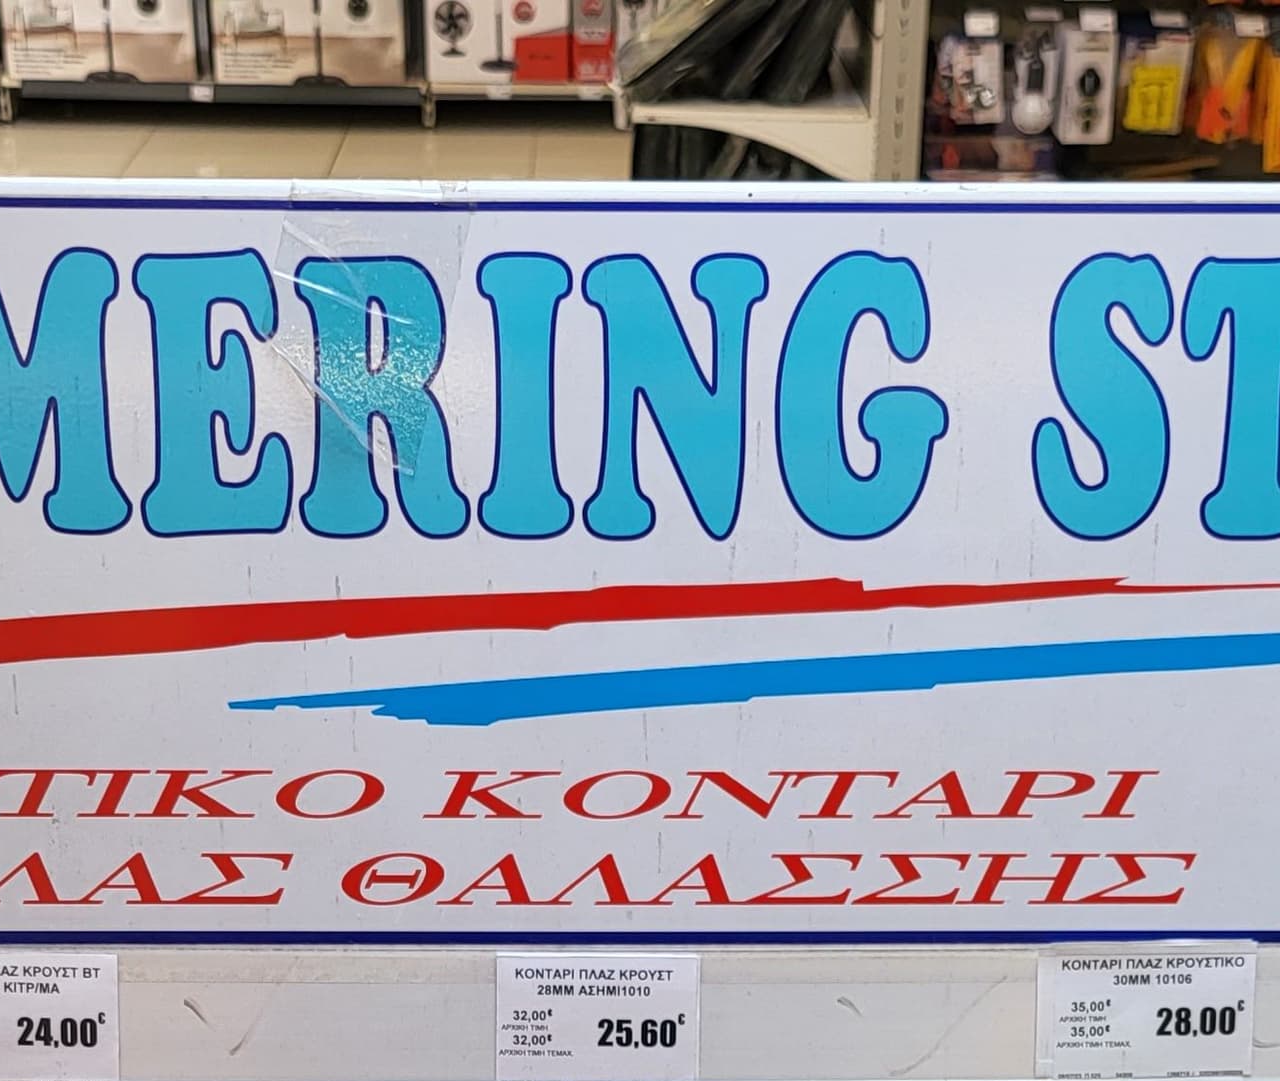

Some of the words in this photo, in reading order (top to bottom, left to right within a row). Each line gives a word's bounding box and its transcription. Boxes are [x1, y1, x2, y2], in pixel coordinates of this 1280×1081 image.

[422, 769, 1161, 820] ΚΟΝΤΑΡΙ
[341, 852, 1197, 907] ΘΑΛΑΣΣΗΣ
[1062, 959, 1121, 970] ΚΟΝΤΑΡΙ
[1126, 958, 1163, 970] ΠΛΑΖ
[1166, 956, 1245, 969] ΚΡΟΥΣΤΙΚΟ
[23, 966, 79, 978] ΚΡΟΥΣΤ
[83, 968, 101, 979] ΒΤ
[515, 968, 575, 980] ΚΟΝΤΑΡΙ
[579, 969, 616, 980] ΠΛΑΖ
[619, 970, 674, 981] ΚΡΟΥΣΤ
